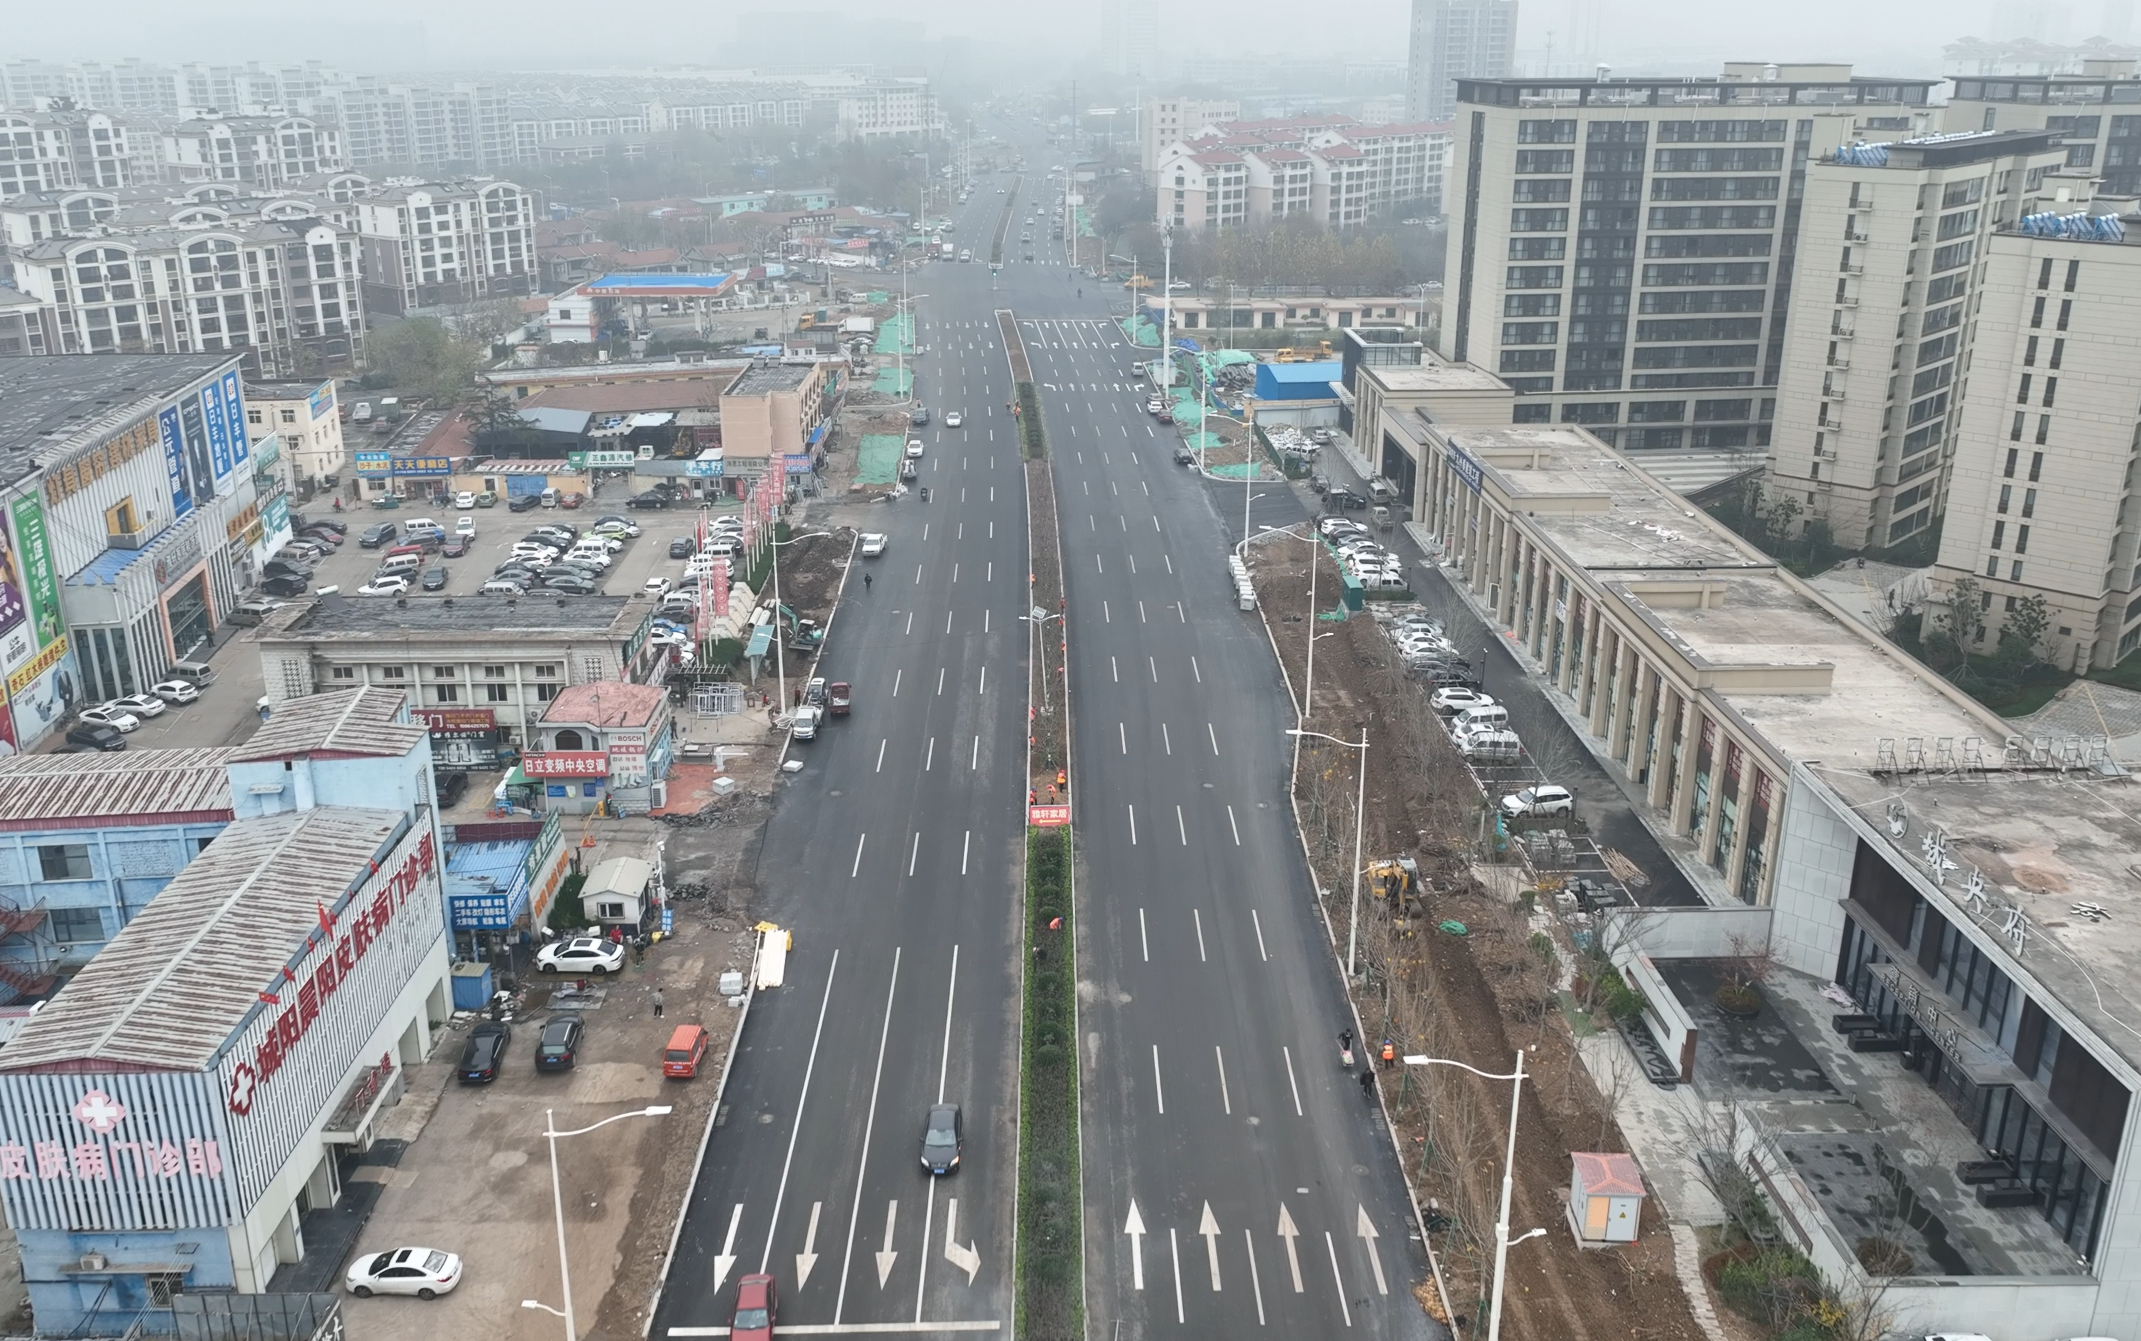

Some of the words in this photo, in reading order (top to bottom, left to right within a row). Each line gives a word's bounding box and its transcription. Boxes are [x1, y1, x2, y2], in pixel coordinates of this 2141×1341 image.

[611, 746, 645, 754] 地暖锅炉
[524, 758, 606, 774] 日立变频中央空调
[1031, 809, 1068, 819] 雅轩家居
[455, 908, 471, 917] 二手车
[254, 831, 434, 1084] 城阳晨阳皮肤病门诊部
[1880, 972, 1921, 1020] RECEPTION
[1930, 1026, 1963, 1064] CENTER
[0, 1137, 223, 1181] 皮肤病门诊部
